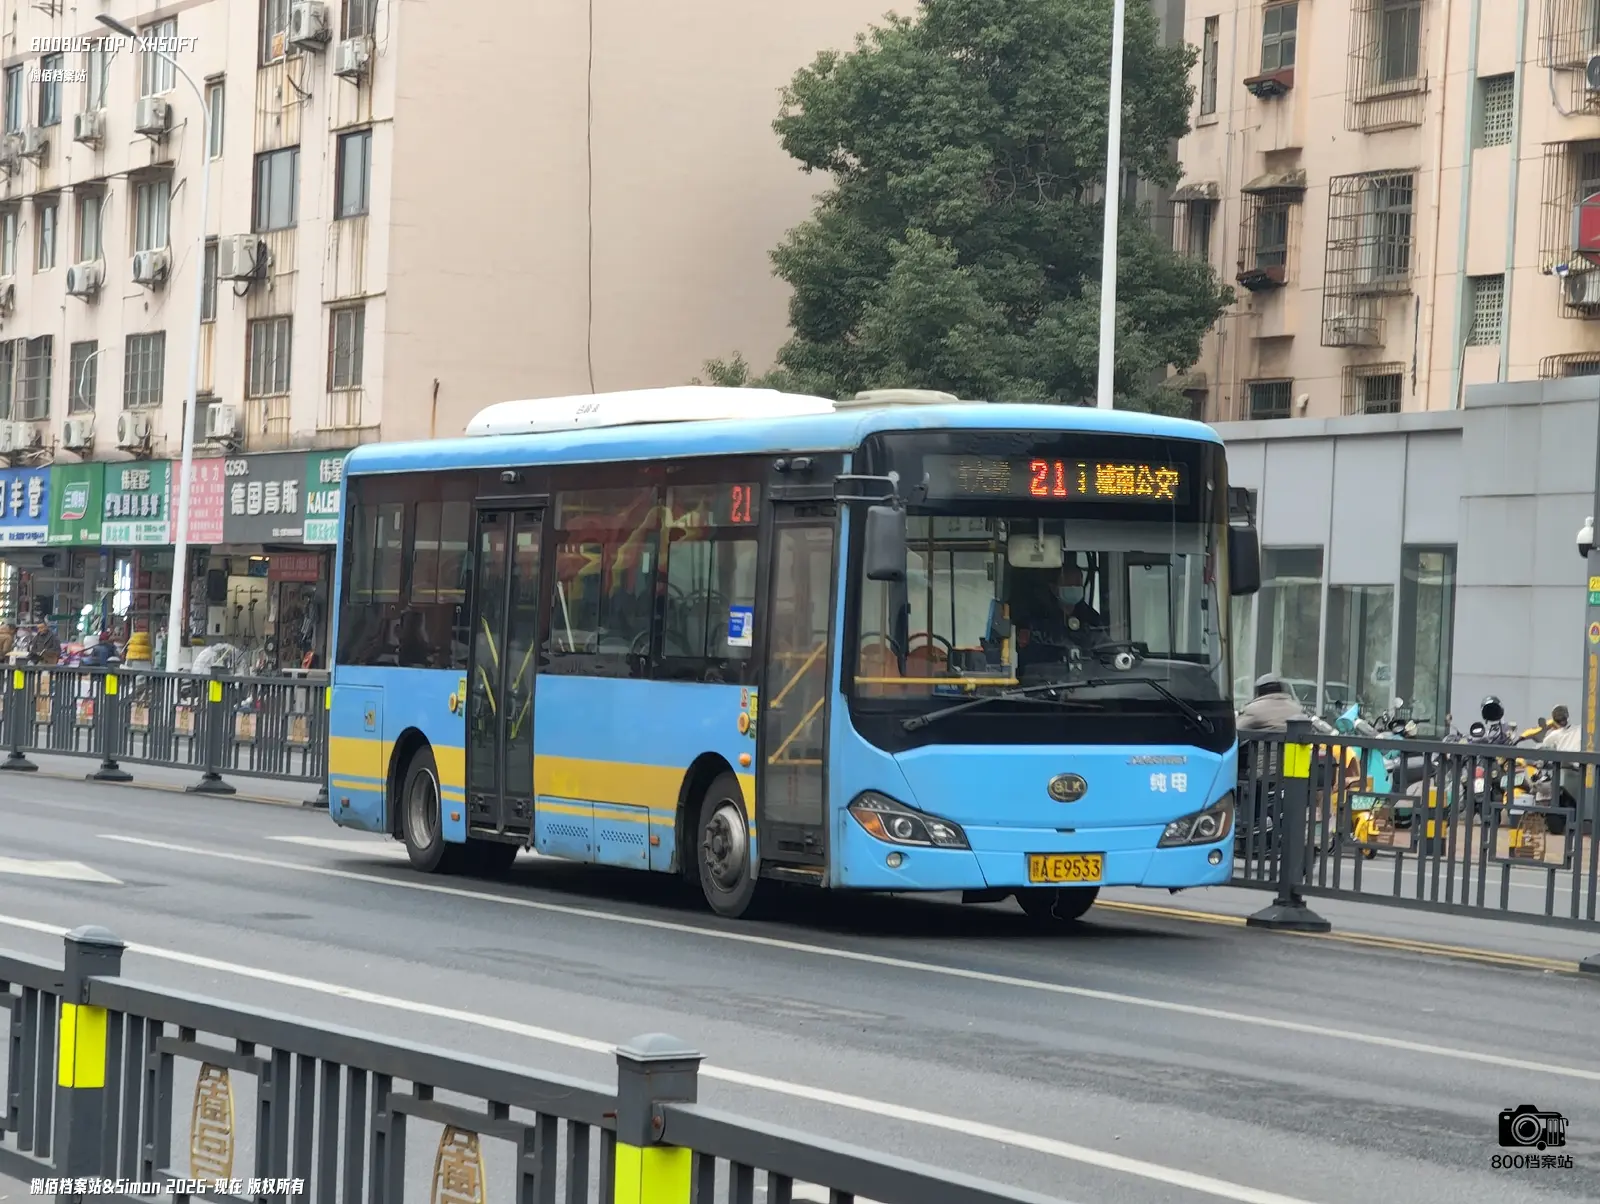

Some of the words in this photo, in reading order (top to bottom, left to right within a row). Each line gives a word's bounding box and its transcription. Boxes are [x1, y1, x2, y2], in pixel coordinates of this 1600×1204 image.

[1029, 459, 1067, 497] 21
[231, 480, 299, 515] 德国高斯
[731, 486, 752, 522] 21
